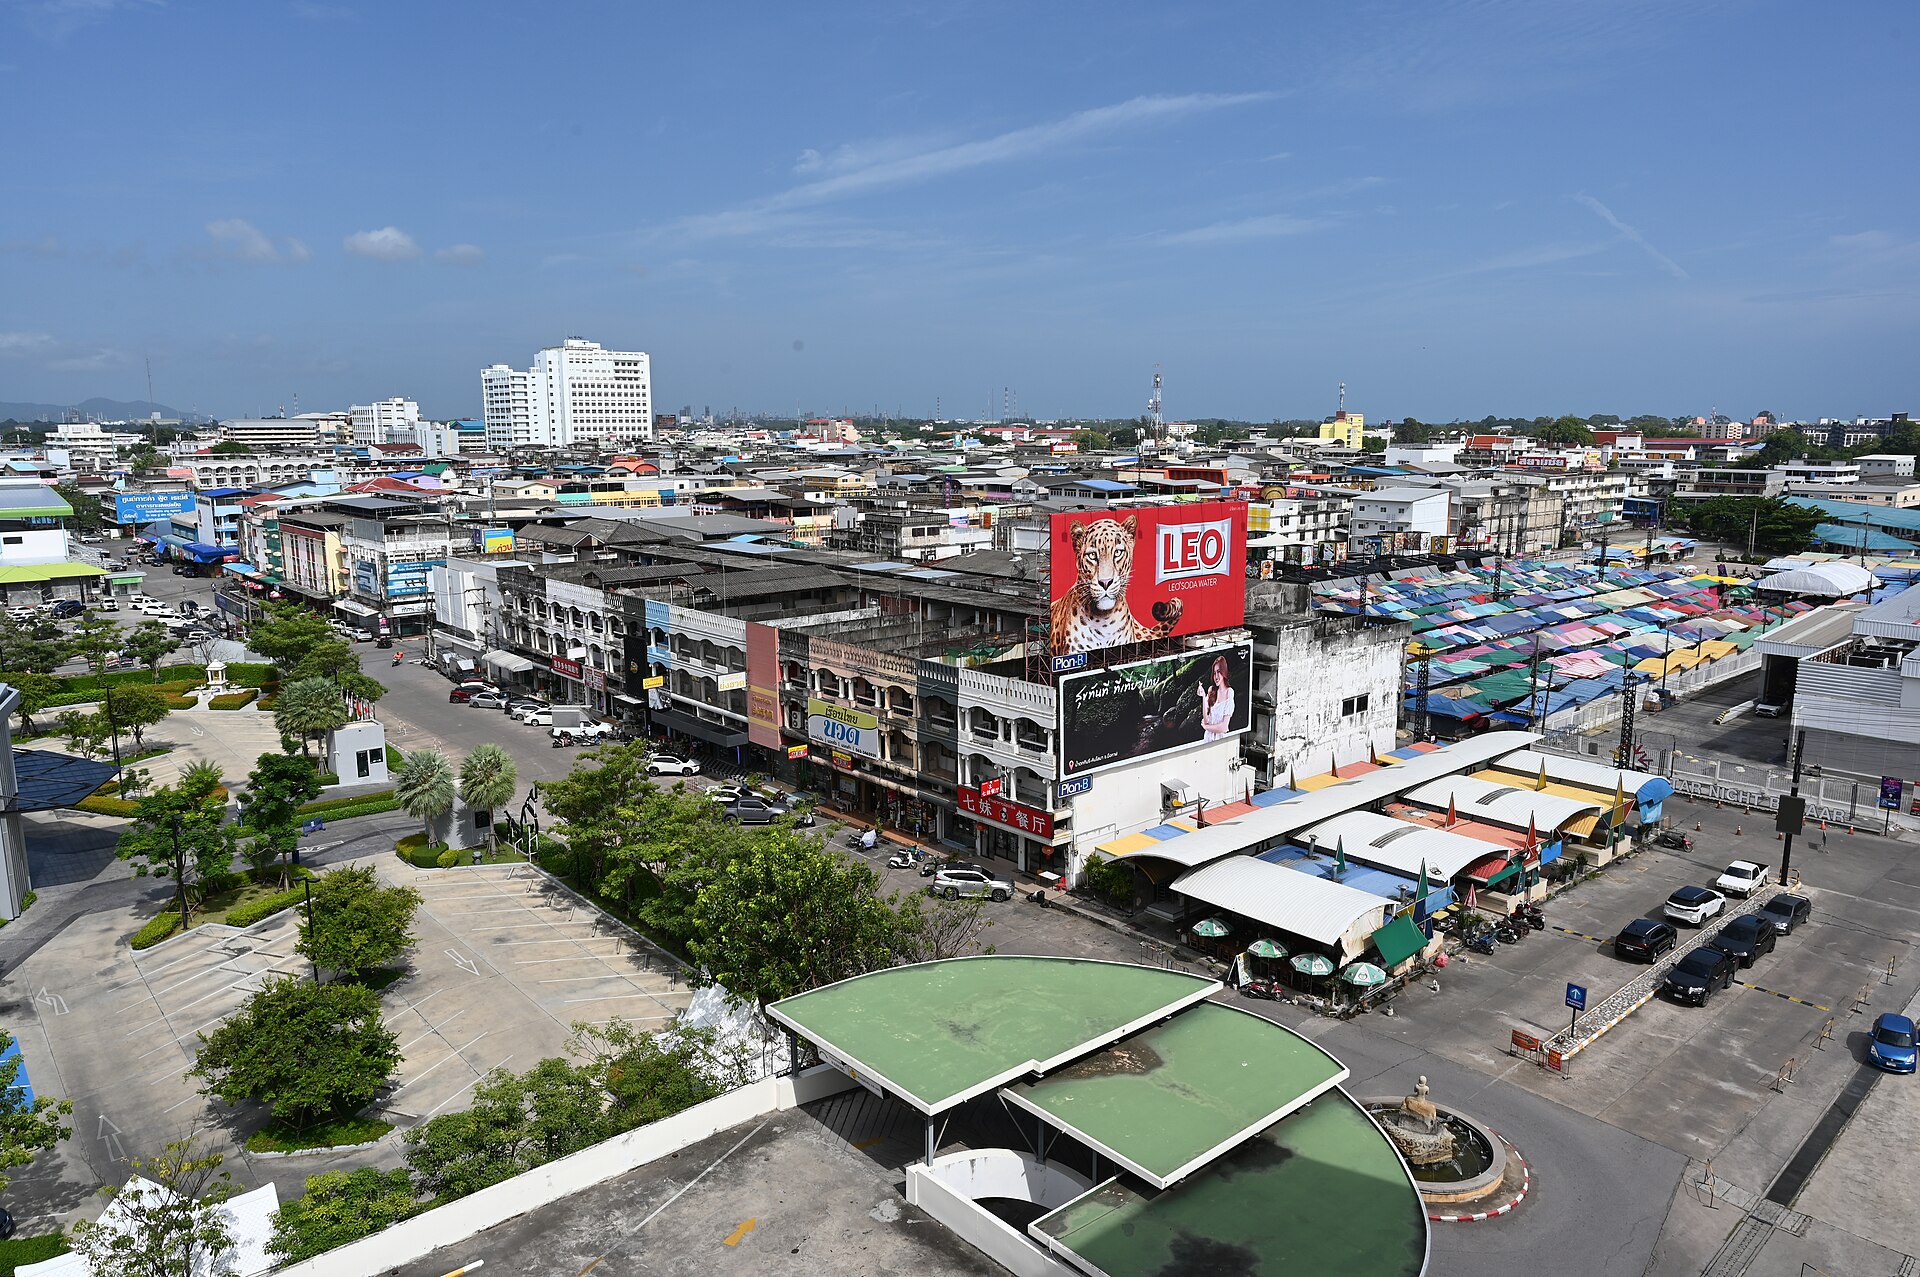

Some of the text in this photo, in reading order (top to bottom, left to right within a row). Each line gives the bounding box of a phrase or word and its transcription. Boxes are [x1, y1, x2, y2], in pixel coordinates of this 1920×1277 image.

[1518, 457, 1564, 466] สยามชัย
[1163, 528, 1226, 574] LEO
[1181, 580, 1197, 590] SODA
[1199, 577, 1218, 587] WATER
[825, 705, 859, 724] เรือนไทย
[823, 719, 861, 746] นวด
[1670, 777, 1846, 823] TAR NIGHT BAAR
[963, 794, 993, 816] 七妹
[1015, 810, 1046, 834] 餐厅
